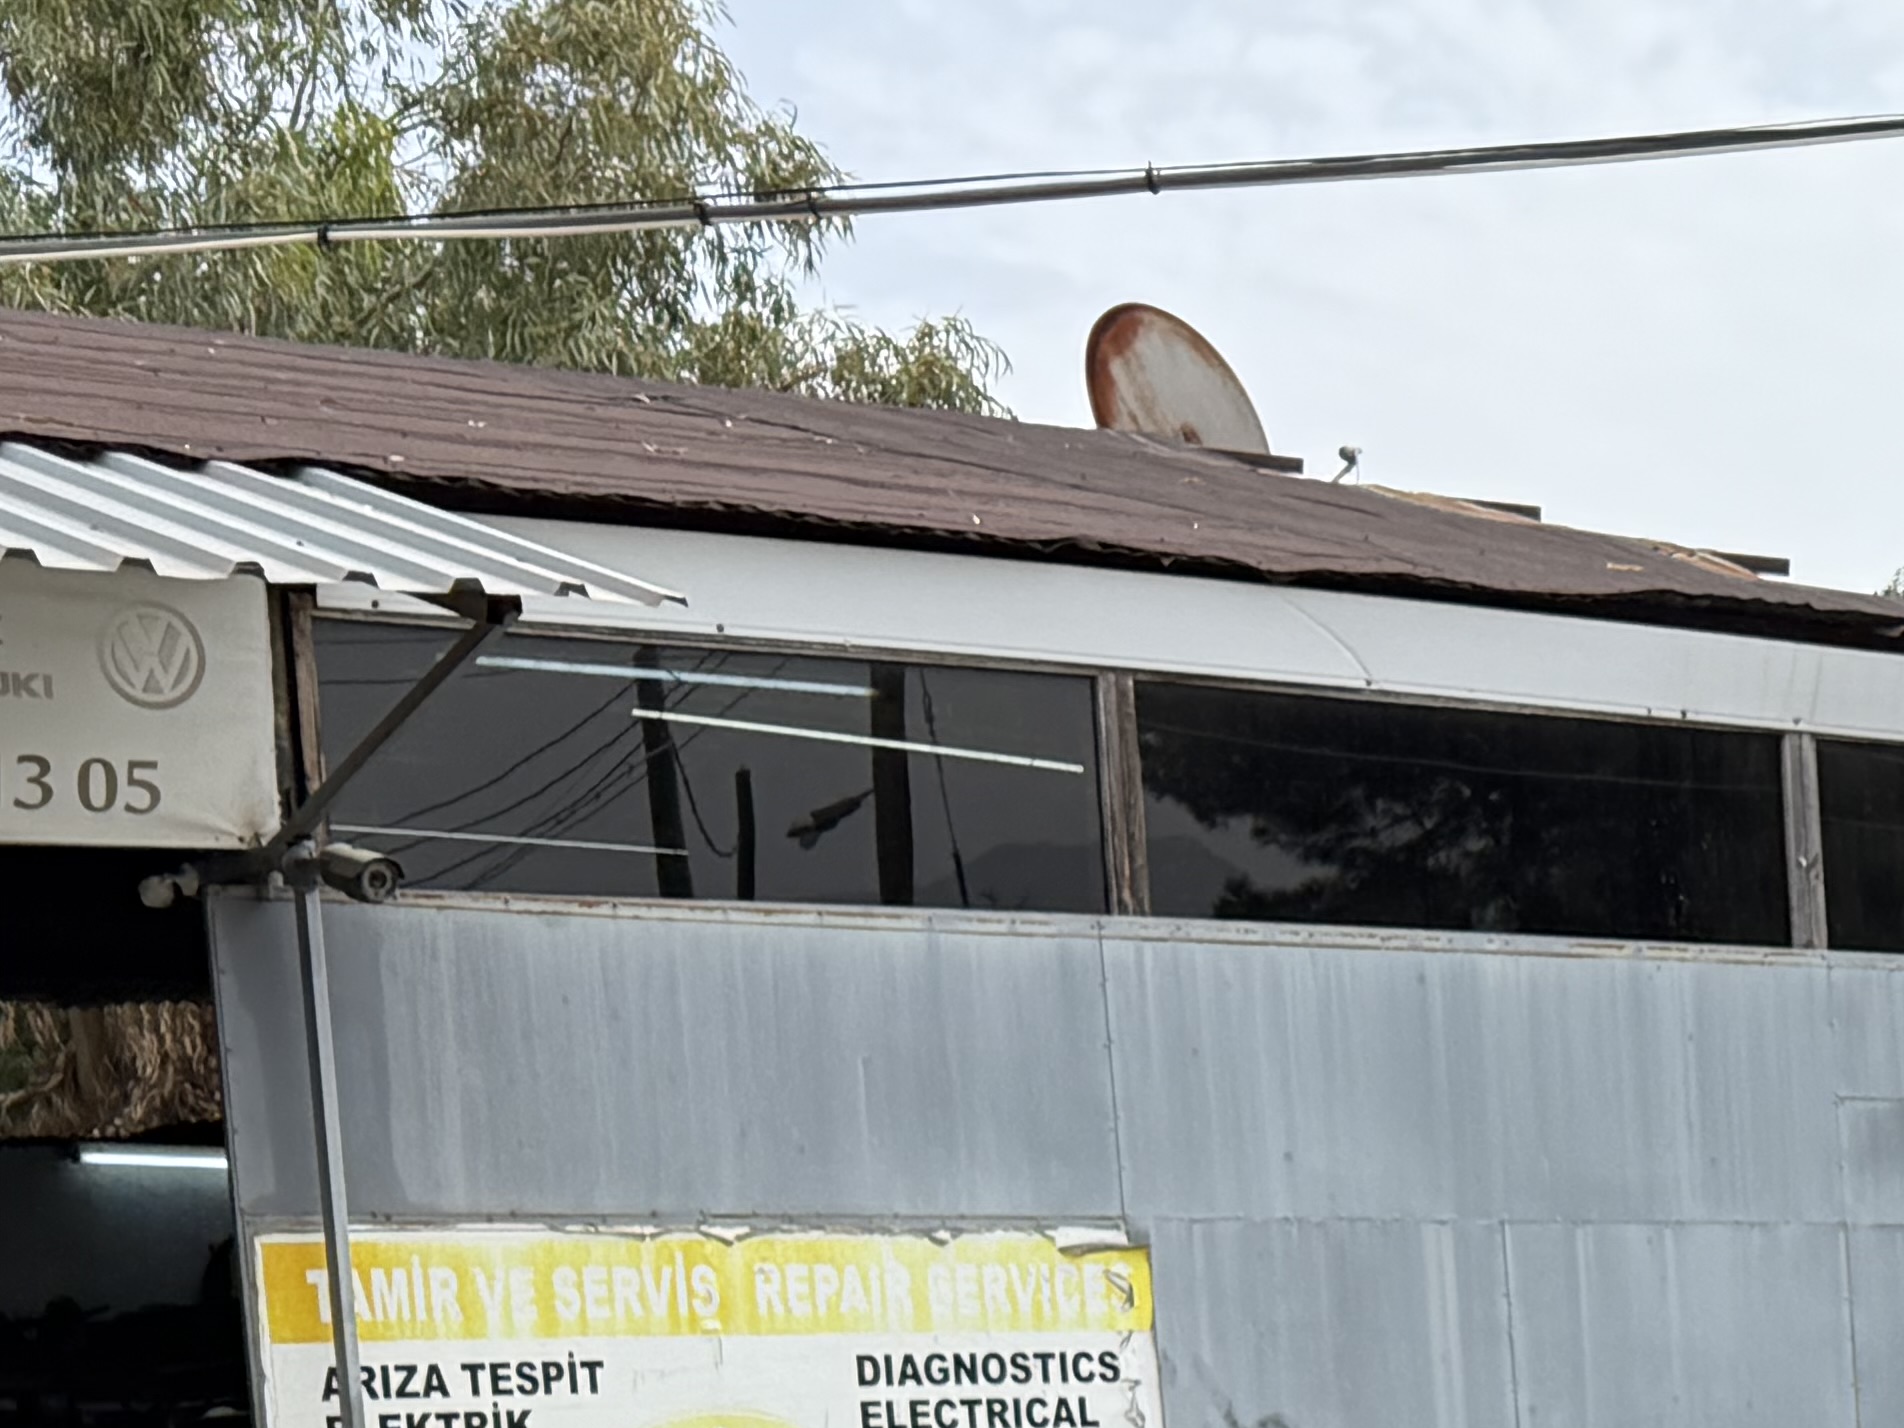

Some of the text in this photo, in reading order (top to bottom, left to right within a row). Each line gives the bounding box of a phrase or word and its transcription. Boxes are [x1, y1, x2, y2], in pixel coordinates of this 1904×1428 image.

[77, 757, 161, 815] 05
[754, 1261, 912, 1320] REPAIR
[460, 1351, 605, 1397] TESPİT
[856, 1351, 1121, 1387] DIAGNOSTICS
